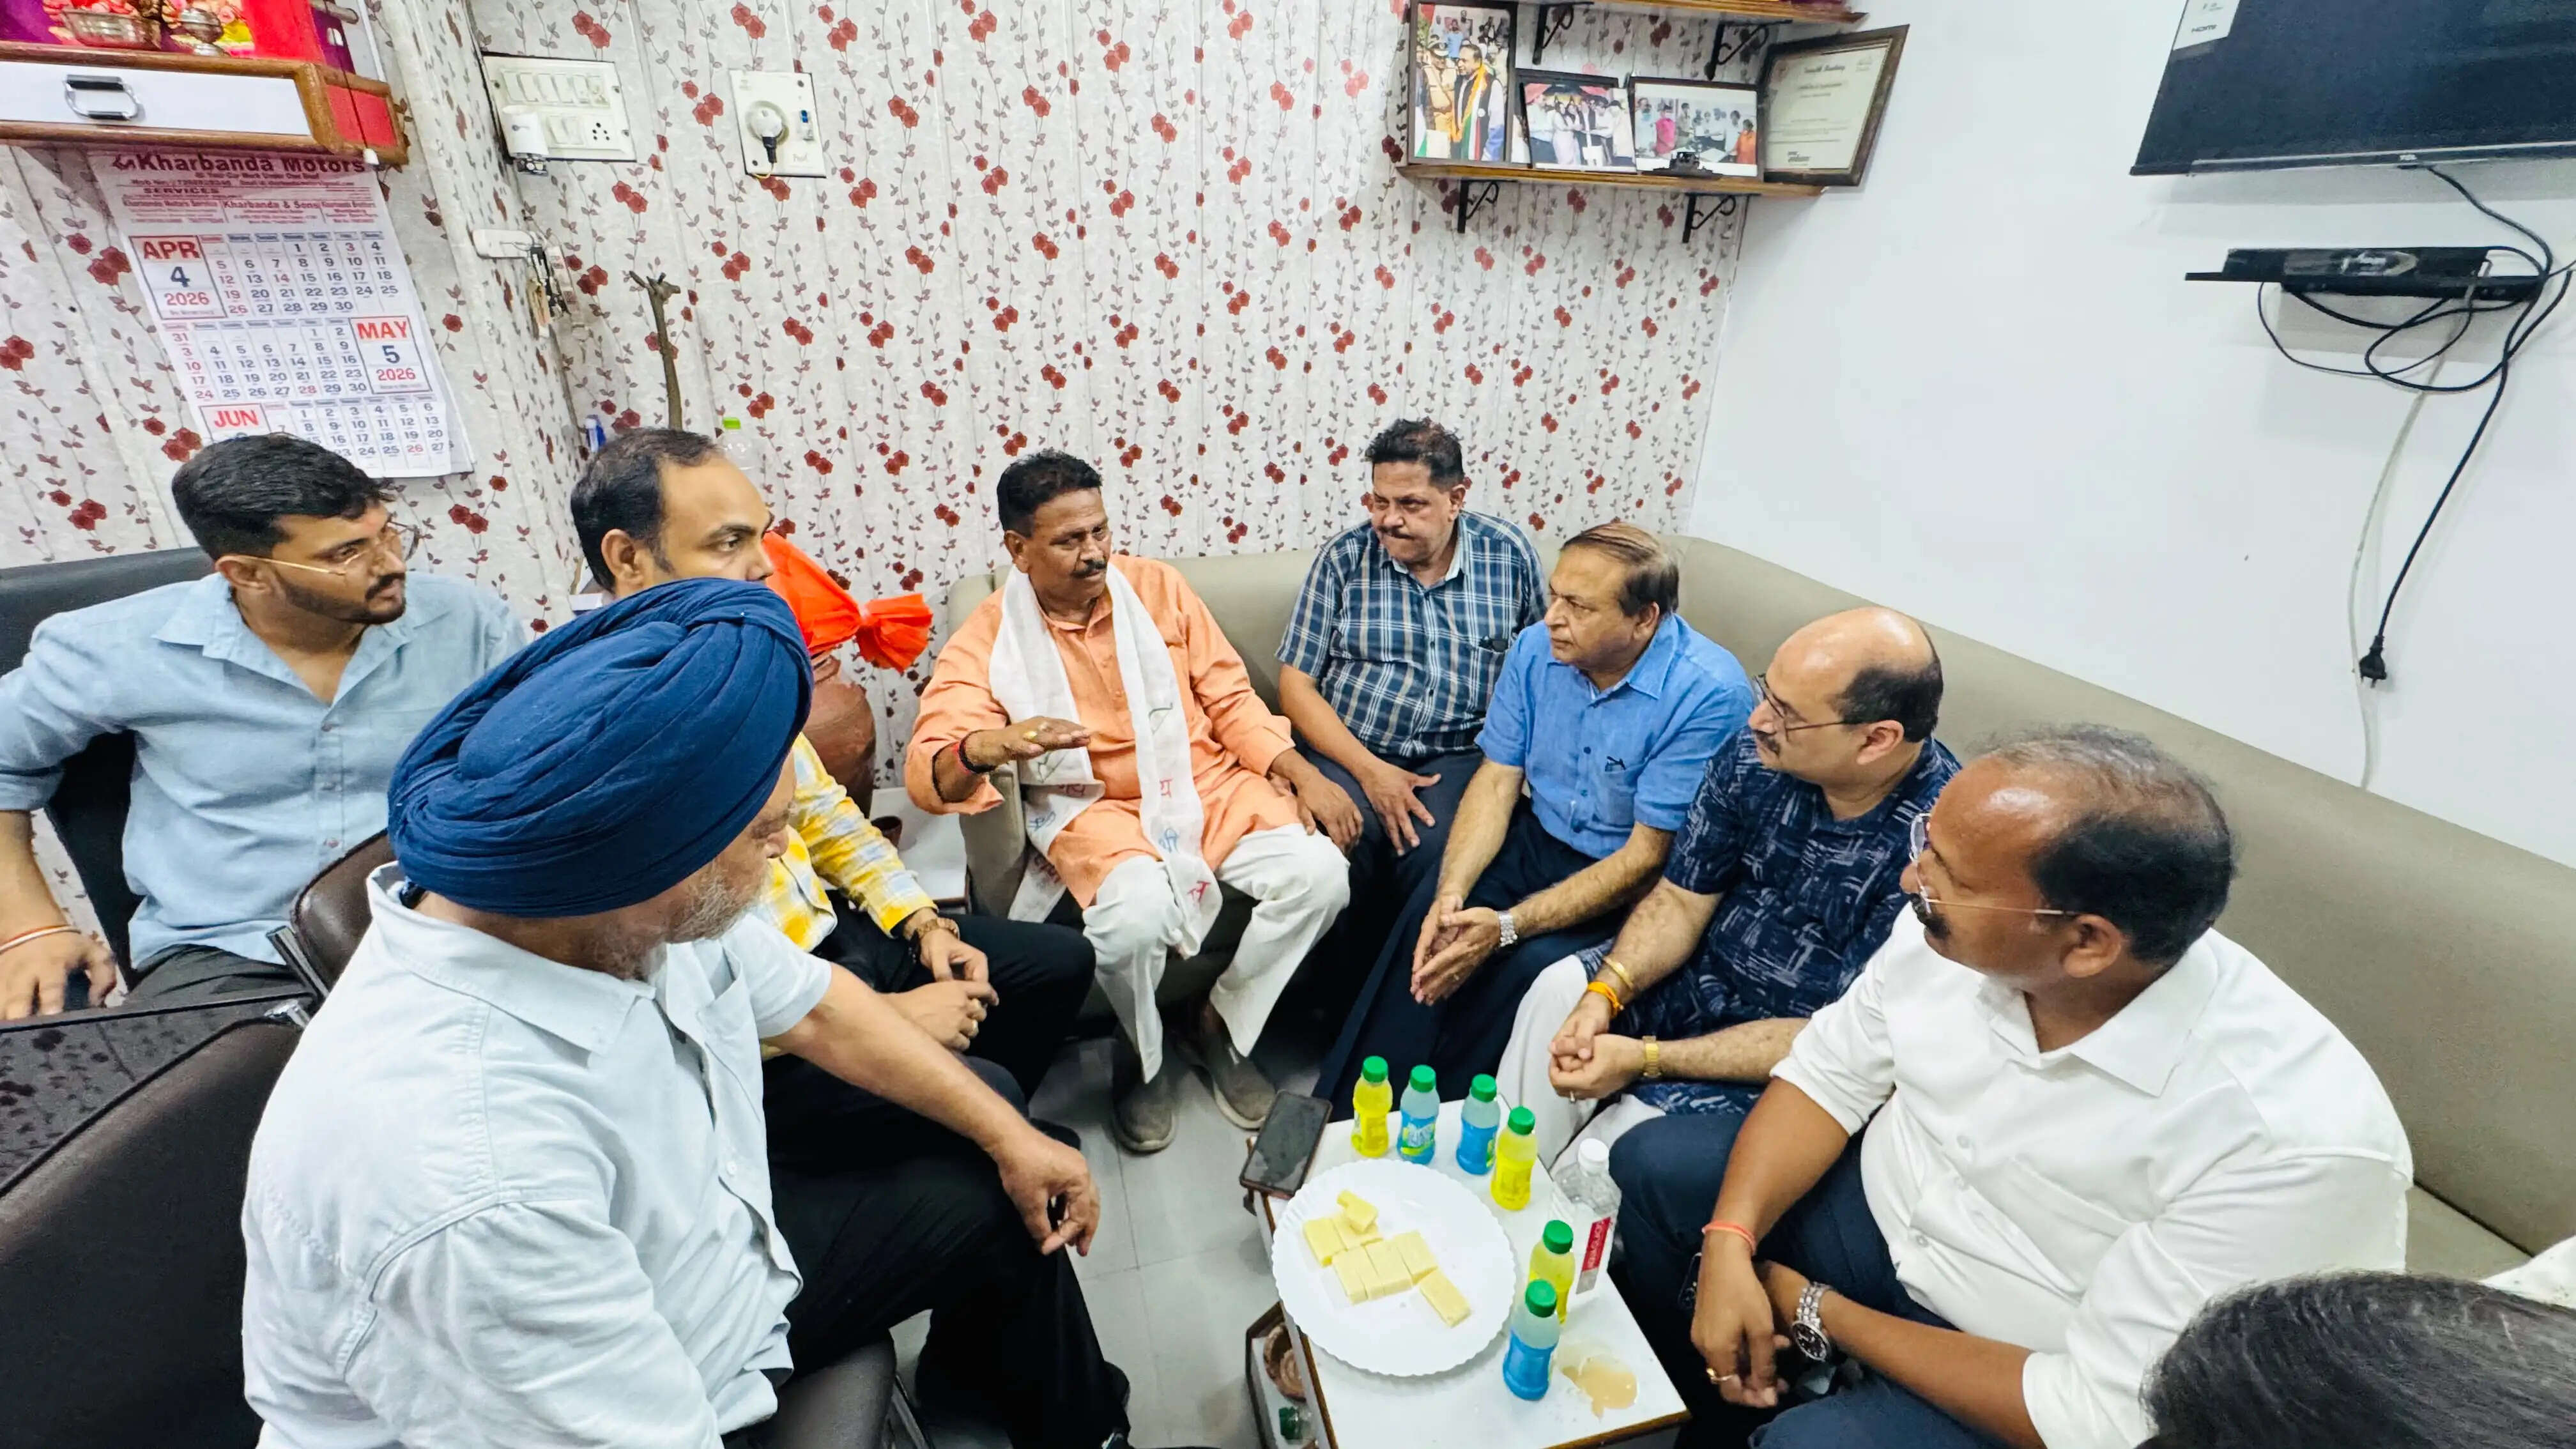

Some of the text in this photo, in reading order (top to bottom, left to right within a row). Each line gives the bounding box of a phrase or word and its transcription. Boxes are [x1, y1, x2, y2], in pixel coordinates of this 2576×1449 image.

[136, 151, 365, 172] Kharbanda Motors
[143, 241, 201, 259] APR
[295, 241, 381, 252] 1 2 3 4
[216, 256, 386, 270] 5 6 7 8 9 10 11
[171, 266, 190, 288] 4
[219, 271, 392, 284] 12 13 14 15 16 17 18
[165, 292, 210, 306] 2026
[224, 286, 399, 299] 19 20 21 22 23 24 25
[228, 301, 353, 314] 26 27 28 29 30
[172, 326, 345, 342] 31 1 2
[356, 321, 407, 340] MAY
[181, 341, 349, 357] 3 4 5 6 7 8 9
[382, 345, 401, 364] 5
[185, 355, 357, 371] 10 11 12 13 14 15 16
[192, 369, 362, 385] 17 18 19 20 21 22 23
[376, 367, 416, 381] 2026
[194, 389, 214, 399] 24
[223, 388, 240, 398] 25
[248, 387, 267, 397] 26
[274, 387, 291, 396] 27
[298, 385, 318, 395] 28
[323, 383, 341, 393] 29
[349, 383, 367, 392] 30
[301, 402, 434, 418] 1 2 3 4 5 6
[215, 410, 259, 428] JUN
[304, 423, 314, 433] 8
[351, 420, 366, 429] 10
[377, 419, 389, 427] 11
[401, 418, 415, 427] 12
[425, 416, 440, 425] 13
[331, 435, 347, 444] 16
[356, 434, 369, 443] 17
[380, 433, 395, 441] 18
[404, 431, 419, 440] 19
[427, 429, 443, 438] 20
[358, 447, 376, 456] 24
[383, 445, 400, 454] 25
[406, 444, 424, 453] 26
[431, 442, 445, 452] 27
